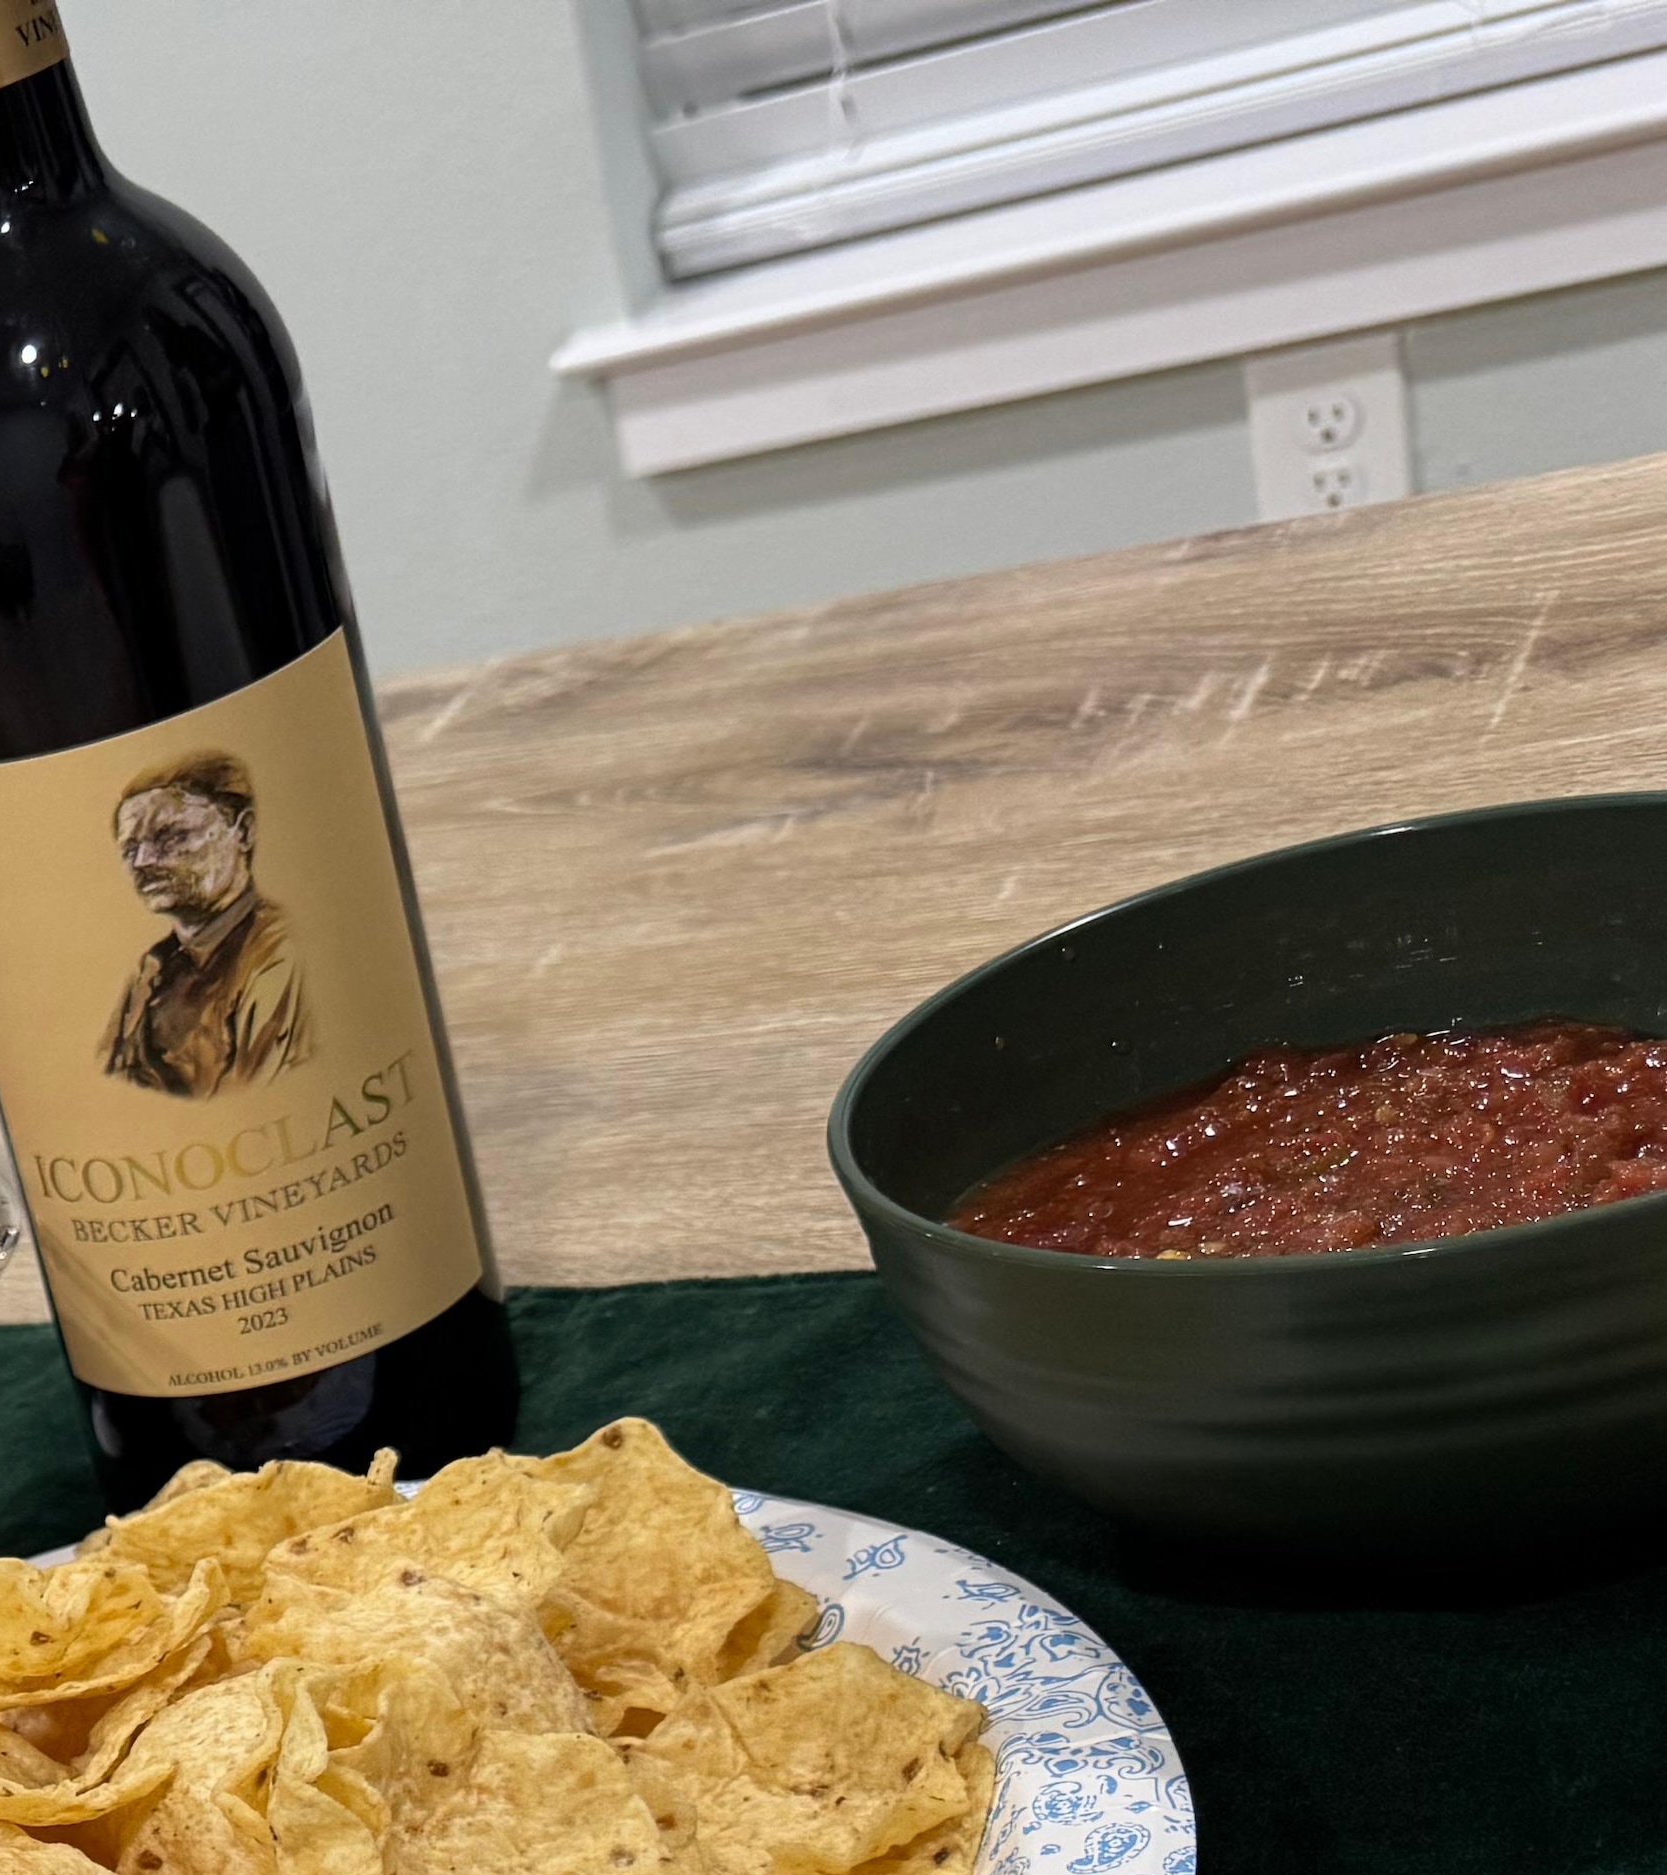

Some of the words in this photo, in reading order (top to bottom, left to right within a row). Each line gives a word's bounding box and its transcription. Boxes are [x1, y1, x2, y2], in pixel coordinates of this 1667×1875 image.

[33, 1050, 416, 1203] ICONOCLAST
[71, 1212, 203, 1243] BECKER
[209, 1131, 408, 1226] VINEYARDS
[111, 1258, 235, 1292] Cabernet
[243, 1203, 394, 1275] Sauvignon
[138, 1296, 216, 1321] TEXAS
[221, 1279, 286, 1310] HIGH
[292, 1244, 377, 1292] PLAINS
[169, 1367, 244, 1386] ALCOHOL
[292, 1349, 312, 1365] BY
[314, 1323, 383, 1357] VOLUME
[237, 1307, 289, 1335] 2023
